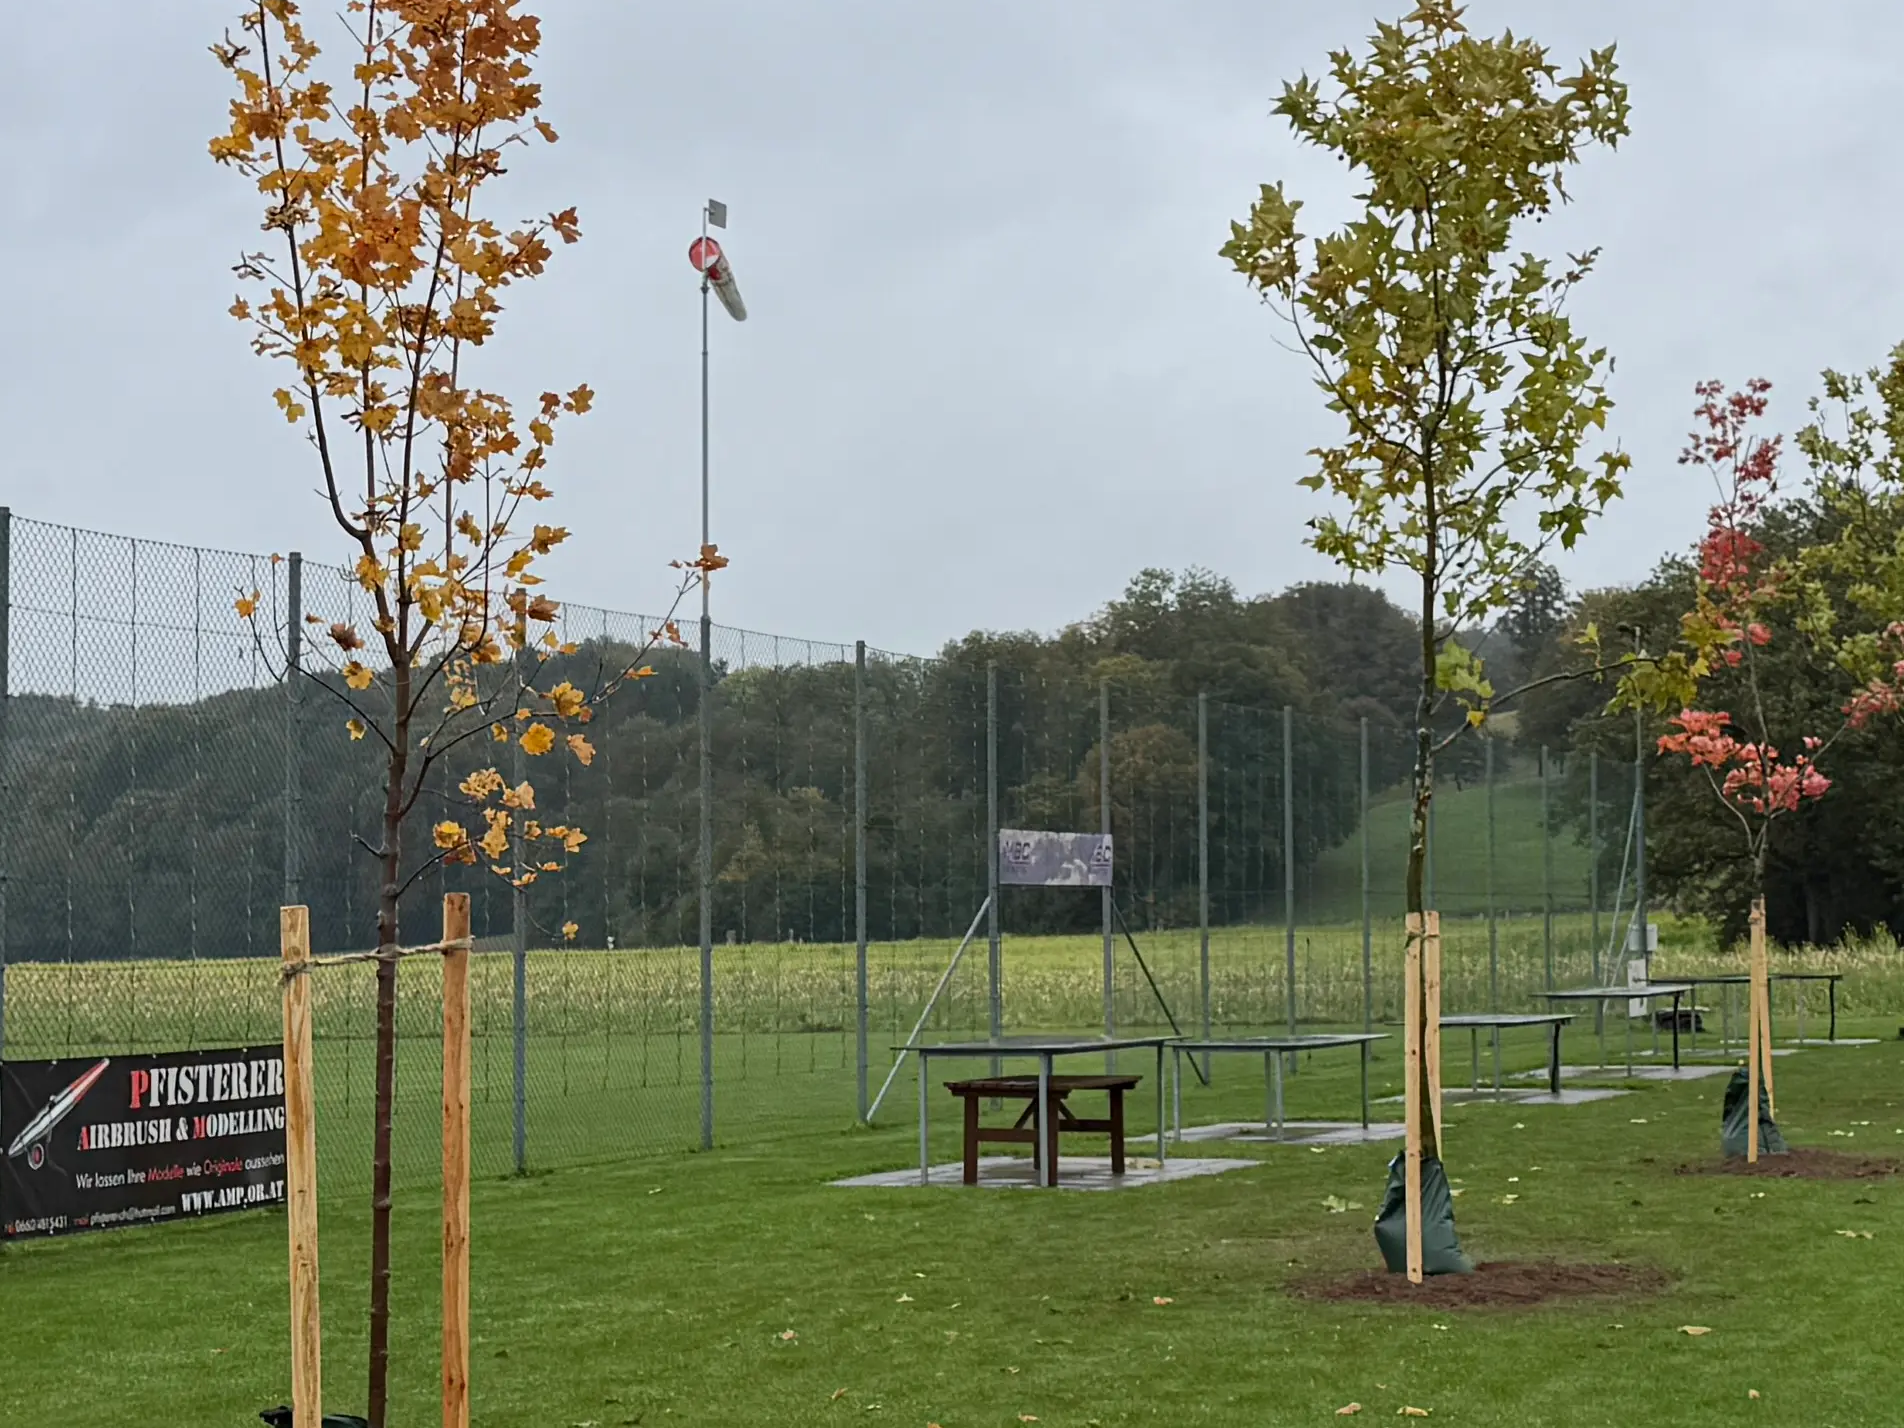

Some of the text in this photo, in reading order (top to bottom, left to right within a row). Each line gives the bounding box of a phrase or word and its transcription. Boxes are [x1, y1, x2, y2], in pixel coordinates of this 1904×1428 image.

[129, 1058, 285, 1109] PFISTERER
[77, 1106, 285, 1151] AIRBRUSH & MODELLING
[76, 1173, 93, 1189] Wir
